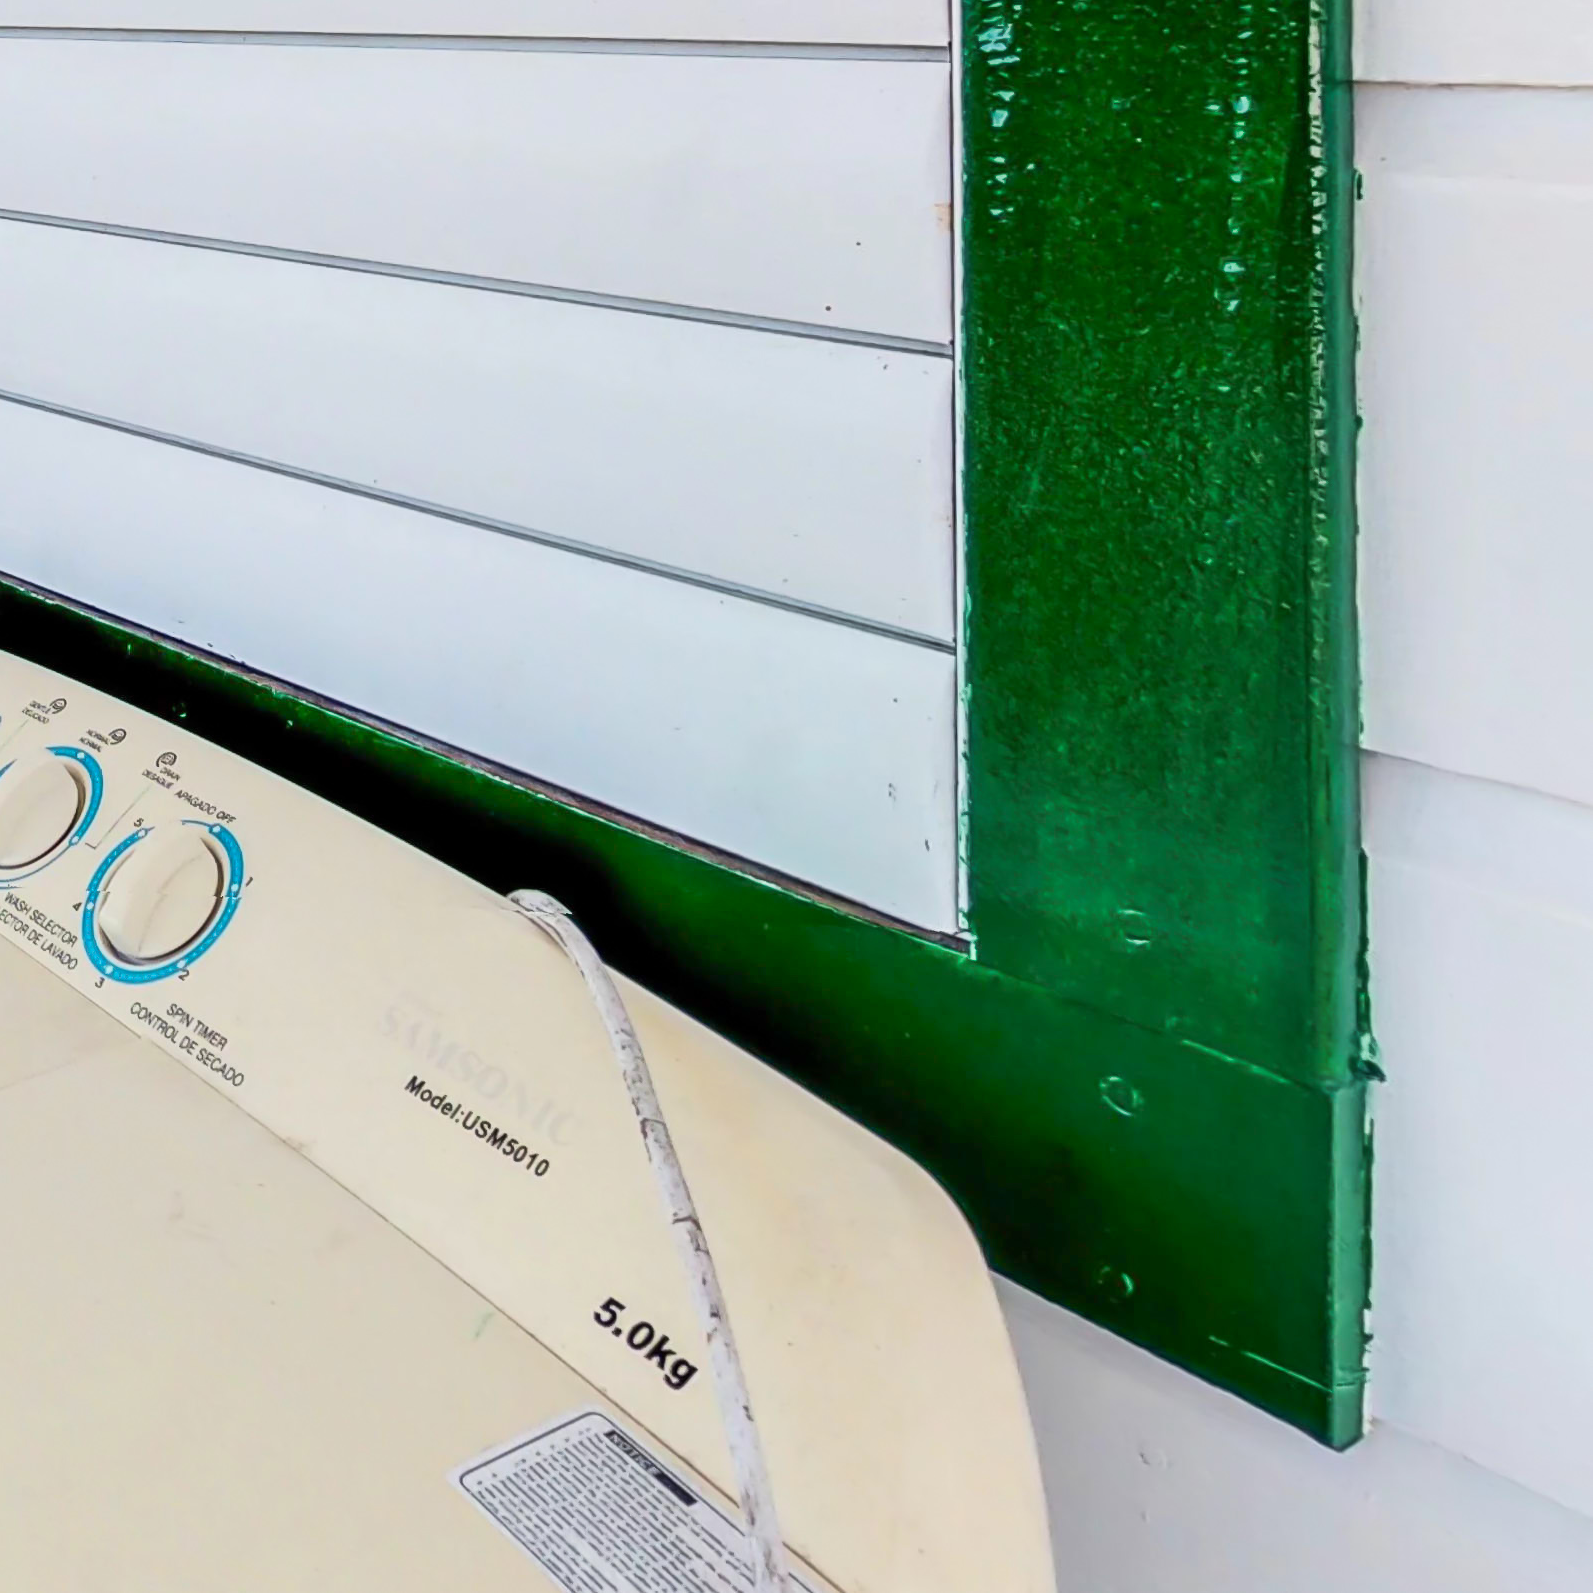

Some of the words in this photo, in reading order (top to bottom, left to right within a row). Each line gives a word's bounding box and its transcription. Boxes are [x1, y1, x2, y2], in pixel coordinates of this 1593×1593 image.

[174, 789, 217, 815] APAGADO
[216, 811, 237, 824] OFF
[4, 892, 31, 917] WASH
[28, 909, 78, 947] SELECTOR
[72, 901, 82, 913] 4
[26, 928, 43, 947] DE
[40, 938, 78, 971] LAVADO
[95, 977, 105, 990] 3
[178, 969, 190, 981] 2
[130, 1002, 179, 1046] CONTROL
[179, 1035, 198, 1054] DE
[195, 1047, 245, 1088] SECADO
[167, 1003, 194, 1028] SPIN
[192, 1019, 228, 1052] TIMER
[404, 1075, 551, 1177] Model:USM5010
[593, 1297, 698, 1390] 5.0kg
